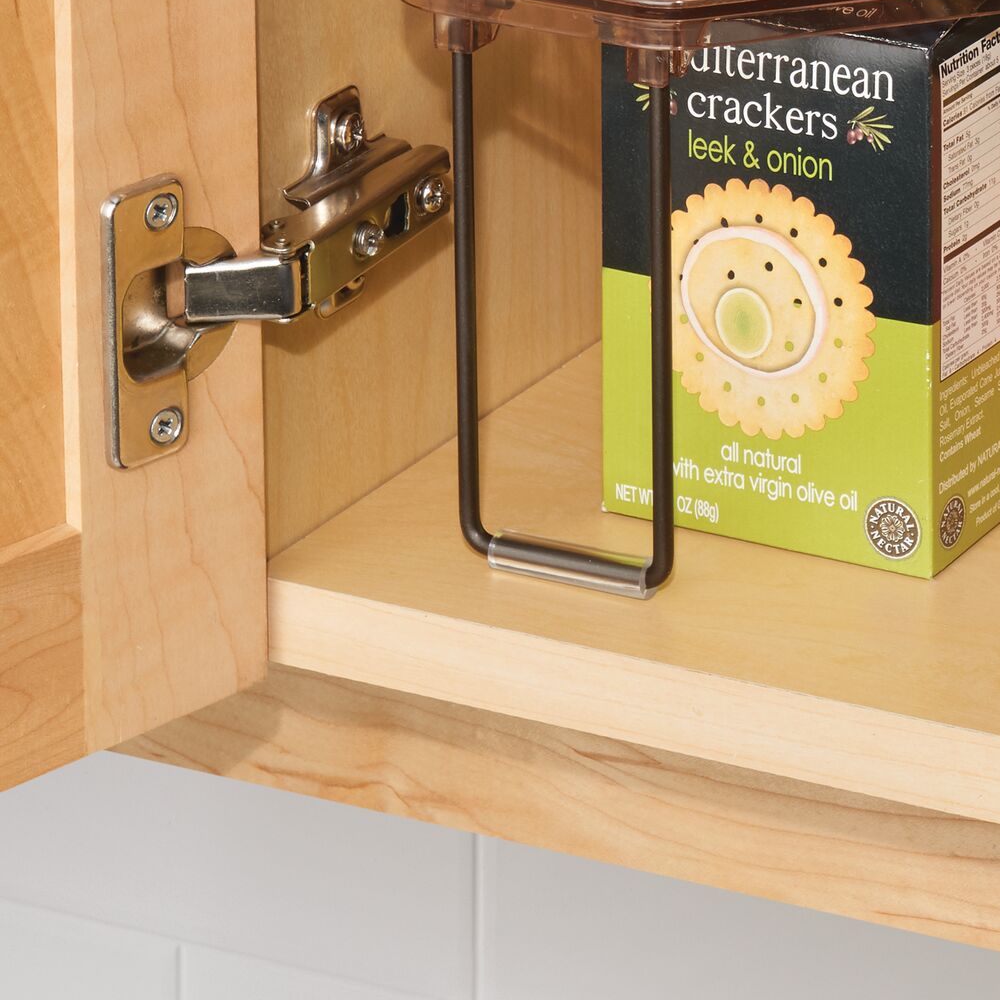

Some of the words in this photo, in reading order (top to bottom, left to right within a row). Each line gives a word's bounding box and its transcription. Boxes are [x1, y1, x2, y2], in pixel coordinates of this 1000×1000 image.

[690, 35, 896, 102] diterranean
[940, 46, 979, 79] Nutrition
[686, 90, 839, 140] crackers
[687, 128, 737, 166] leek
[742, 139, 760, 171] &
[766, 146, 834, 181] onion
[943, 167, 970, 190] Cholesterol
[956, 183, 987, 207] Carbohydrate
[720, 441, 740, 464] all
[743, 447, 803, 475] natural
[940, 439, 964, 463] Contains
[964, 426, 982, 445] Wheat
[703, 466, 746, 490] extra
[749, 473, 793, 502] virgin
[797, 482, 836, 508] olive
[839, 489, 858, 512] oil
[938, 462, 969, 495] Distributed
[969, 459, 977, 473] by
[615, 482, 637, 503] NET
[637, 486, 654, 506] WT
[677, 494, 693, 515] OZ
[694, 498, 720, 524] (88g)
[868, 501, 916, 532] NATURAL
[975, 510, 993, 527] Product
[870, 529, 915, 555] NECTAR
